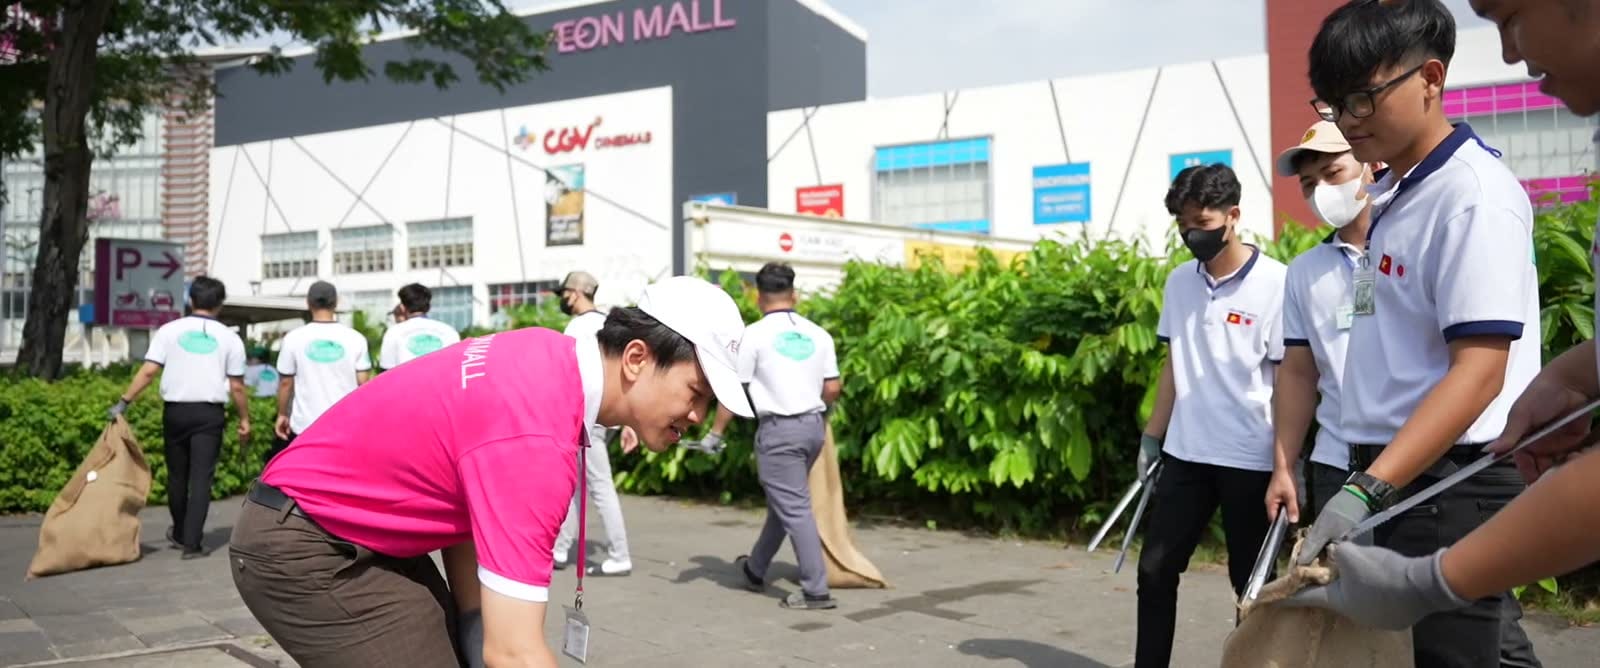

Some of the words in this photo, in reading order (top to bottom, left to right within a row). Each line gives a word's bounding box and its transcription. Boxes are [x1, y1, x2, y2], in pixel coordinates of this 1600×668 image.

[632, 0, 737, 41] MALL
[543, 123, 595, 154] CGV
[116, 247, 142, 281] P
